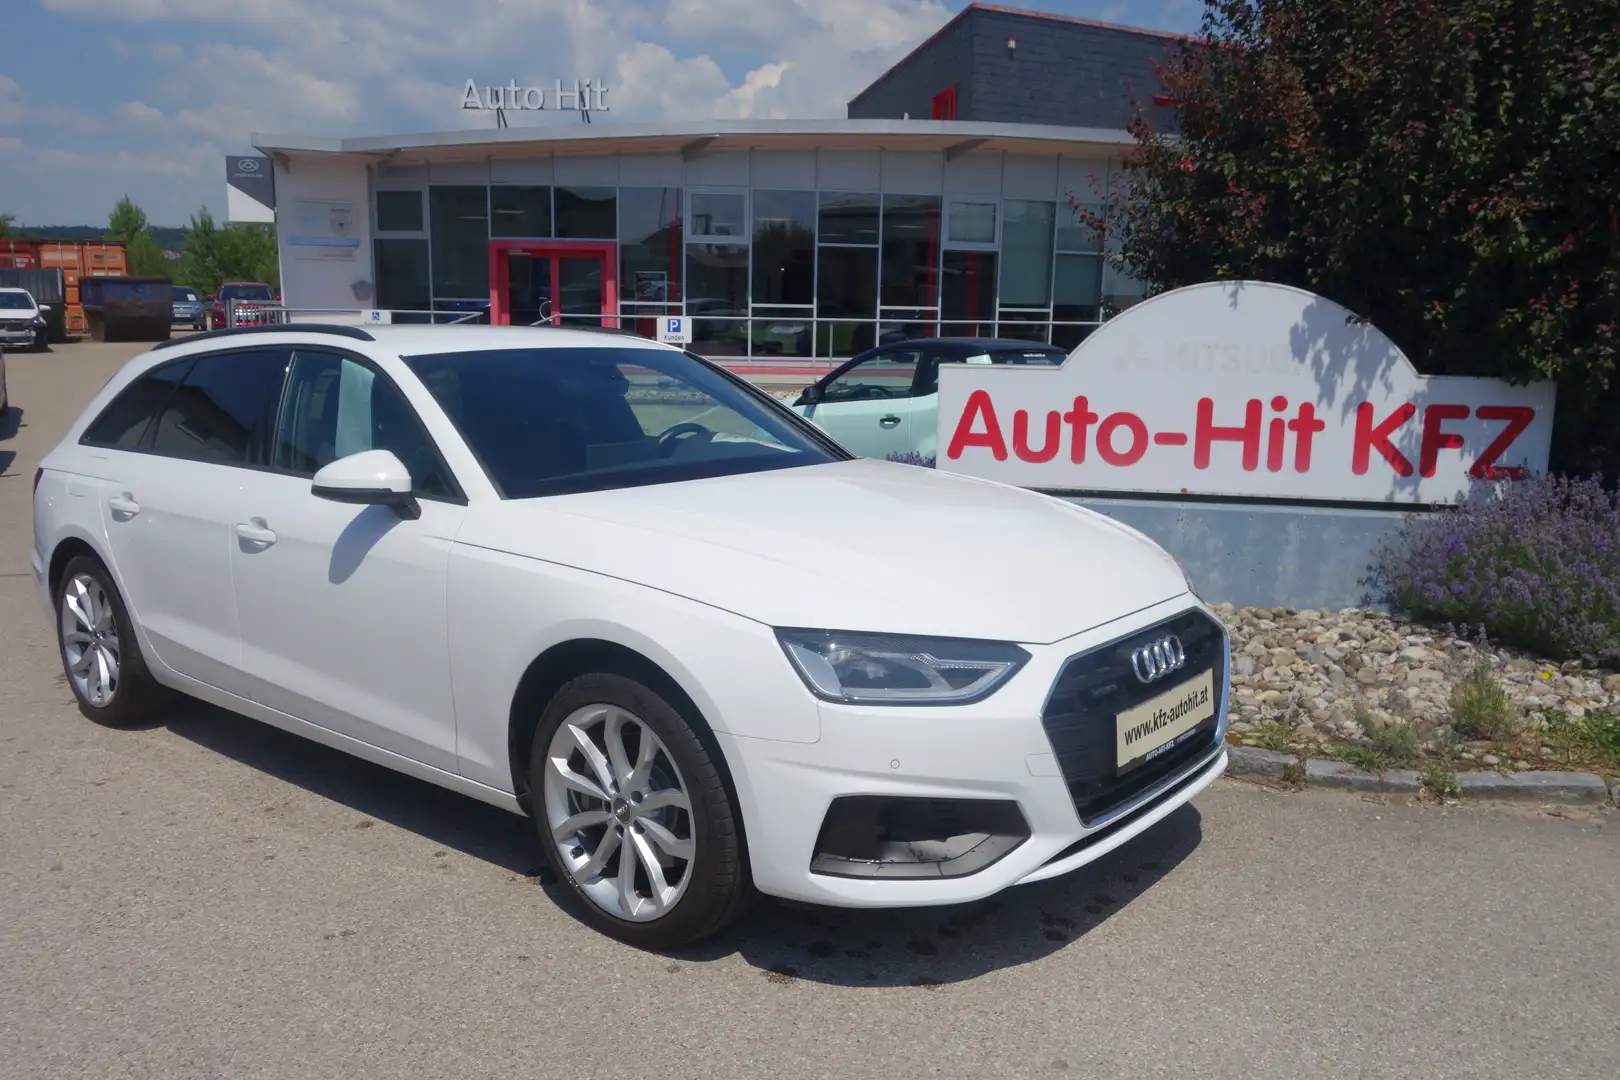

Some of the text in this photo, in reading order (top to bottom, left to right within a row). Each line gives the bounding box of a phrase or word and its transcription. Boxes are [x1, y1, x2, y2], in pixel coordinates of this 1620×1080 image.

[463, 78, 610, 110] Auto Hit
[670, 319, 679, 332] P
[947, 390, 1536, 481] Auto-Hit KFZ
[1124, 684, 1209, 746] www.kfz-autohit.at
